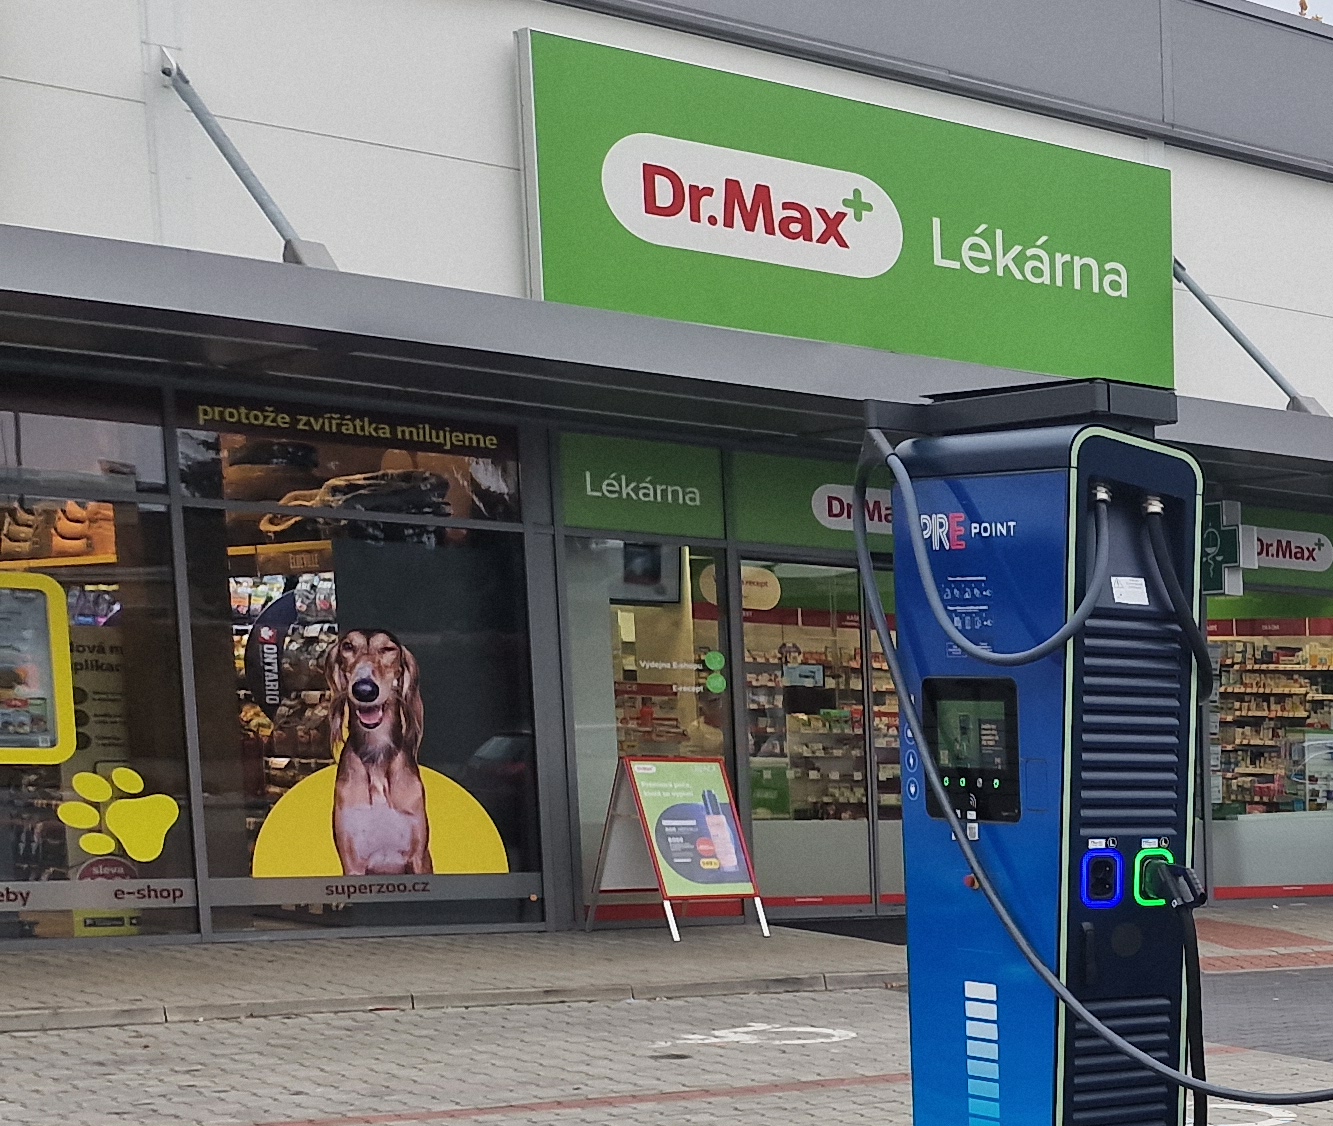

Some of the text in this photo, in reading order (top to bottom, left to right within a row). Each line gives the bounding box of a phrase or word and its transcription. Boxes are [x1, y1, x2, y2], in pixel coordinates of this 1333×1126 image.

[641, 162, 850, 250] Dr.Max
[931, 217, 1130, 298] Lékárna
[198, 404, 498, 449] protože zvířátka milujeme
[585, 471, 700, 506] Lékárna
[971, 521, 1016, 538] POINT
[262, 644, 280, 705] ONTARIO
[114, 884, 184, 904] e-shop
[325, 878, 430, 899] superzoo.cz
